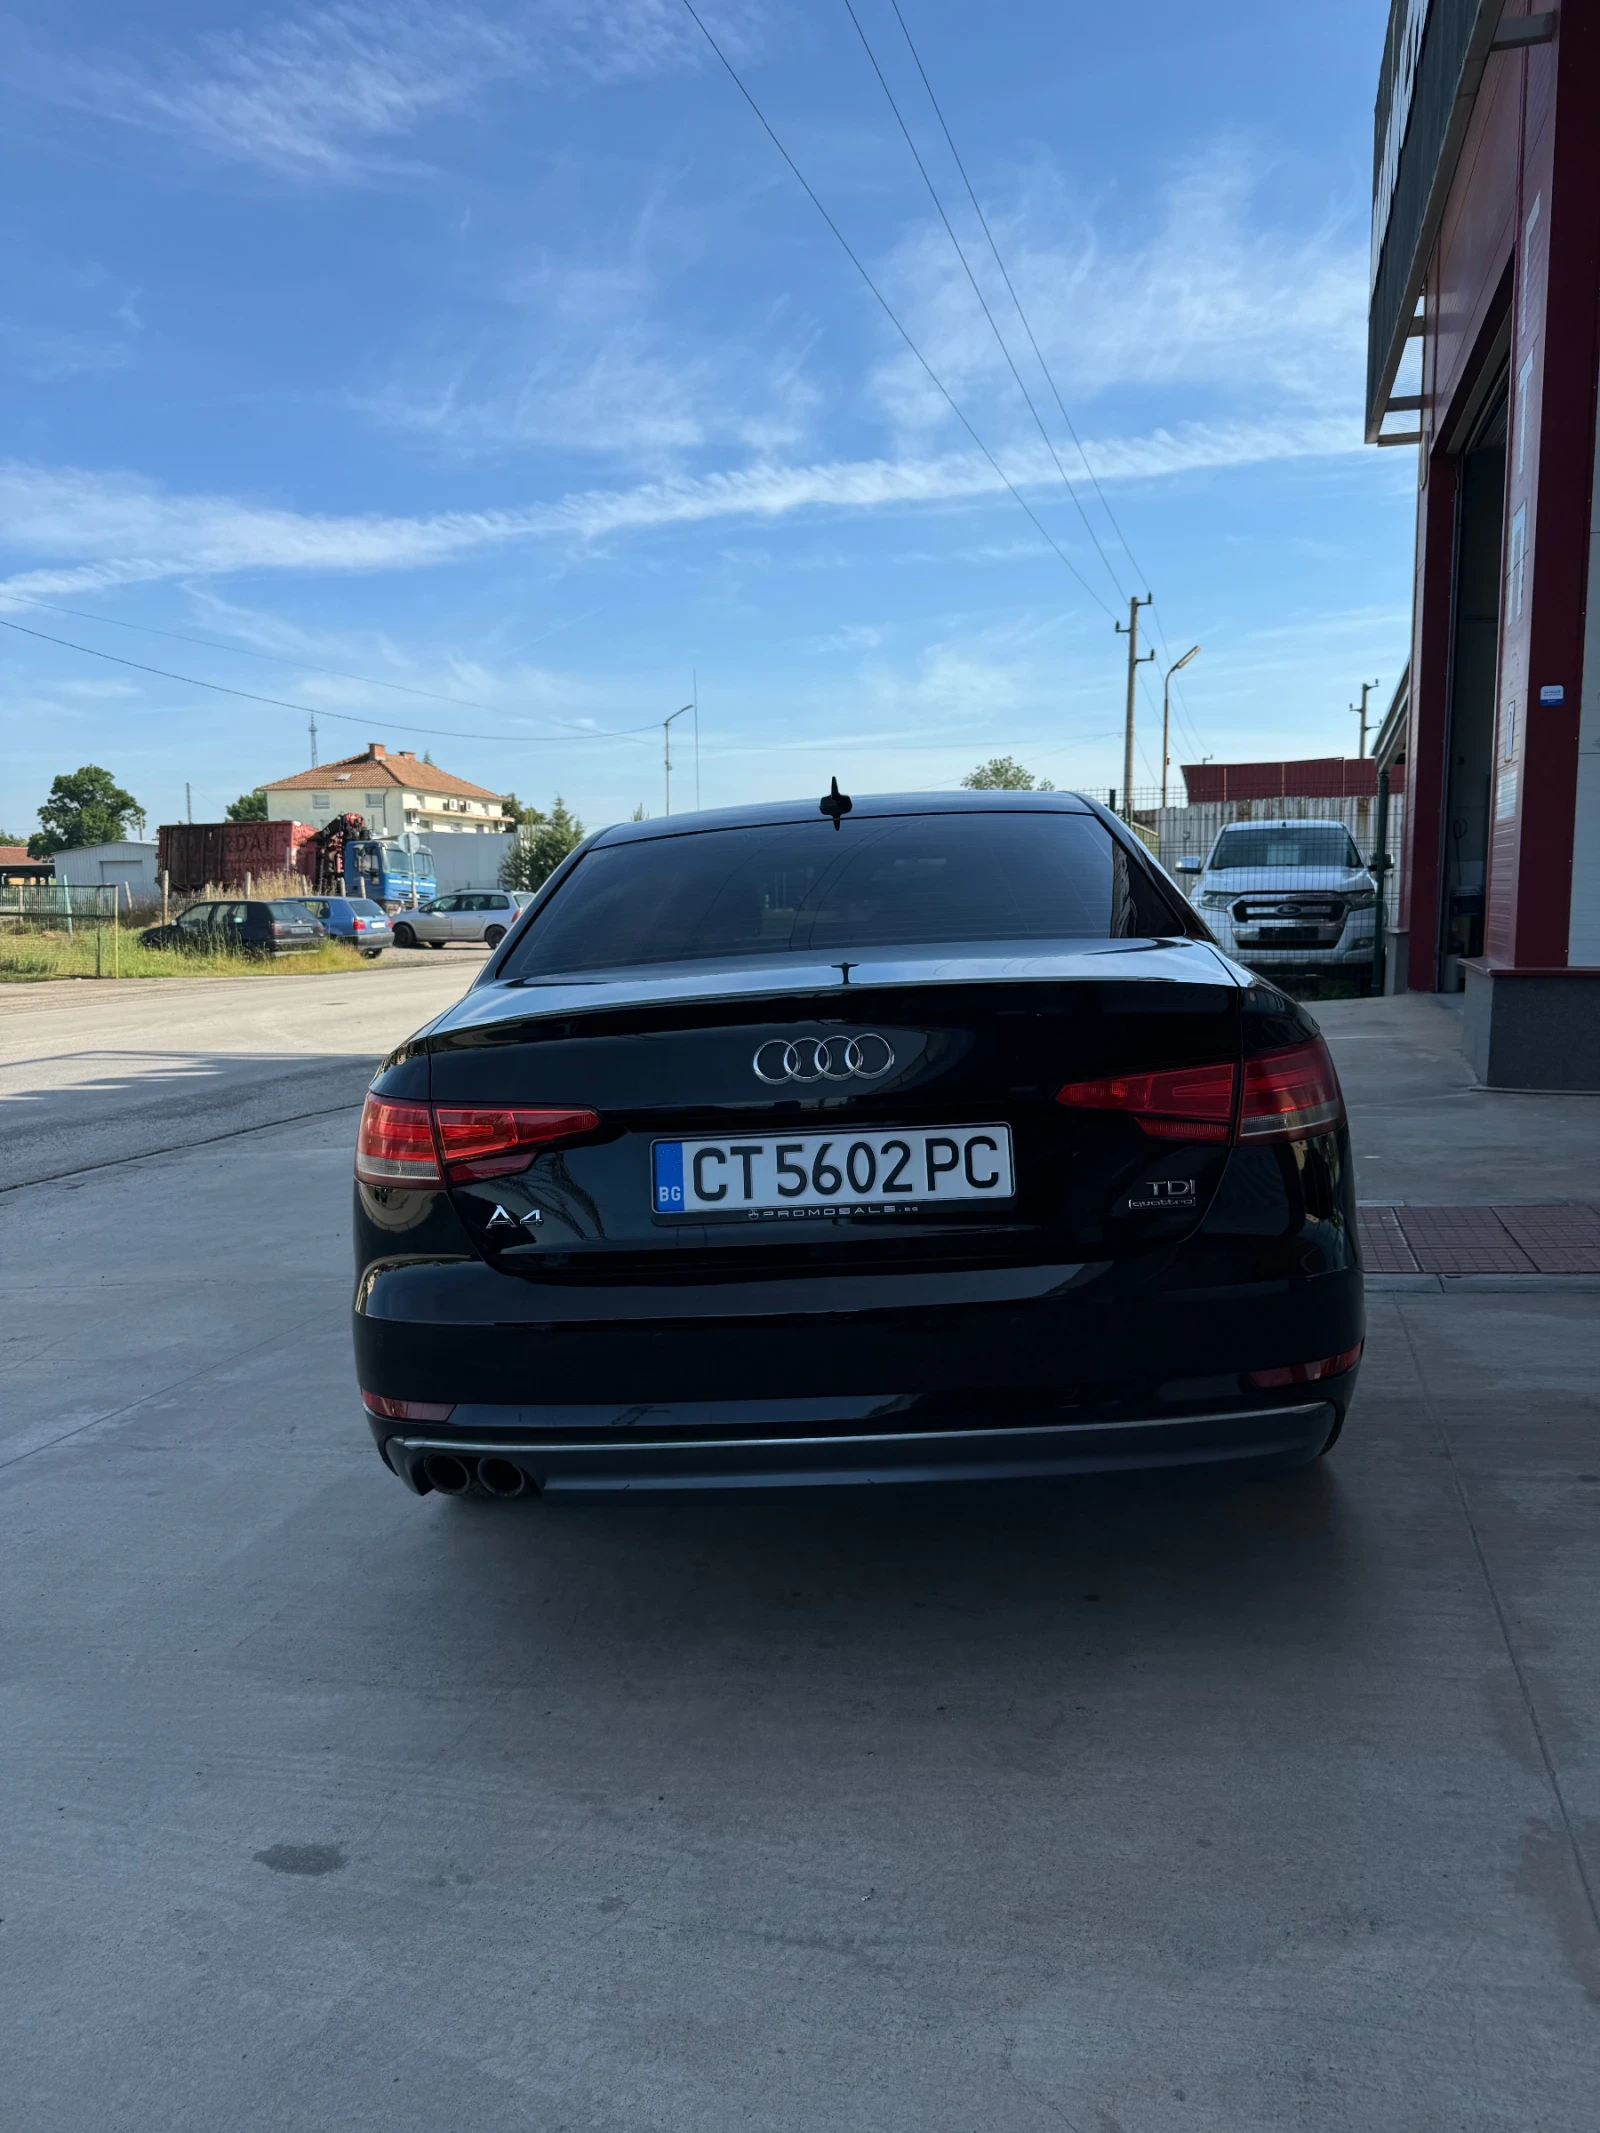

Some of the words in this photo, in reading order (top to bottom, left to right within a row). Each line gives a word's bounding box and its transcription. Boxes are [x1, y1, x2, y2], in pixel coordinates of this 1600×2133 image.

[776, 1139, 913, 1197] 5602
[659, 1185, 682, 1203] BG
[1145, 1179, 1196, 1196] TDI
[1131, 1199, 1193, 1208] quattro
[485, 1204, 543, 1229] A4
